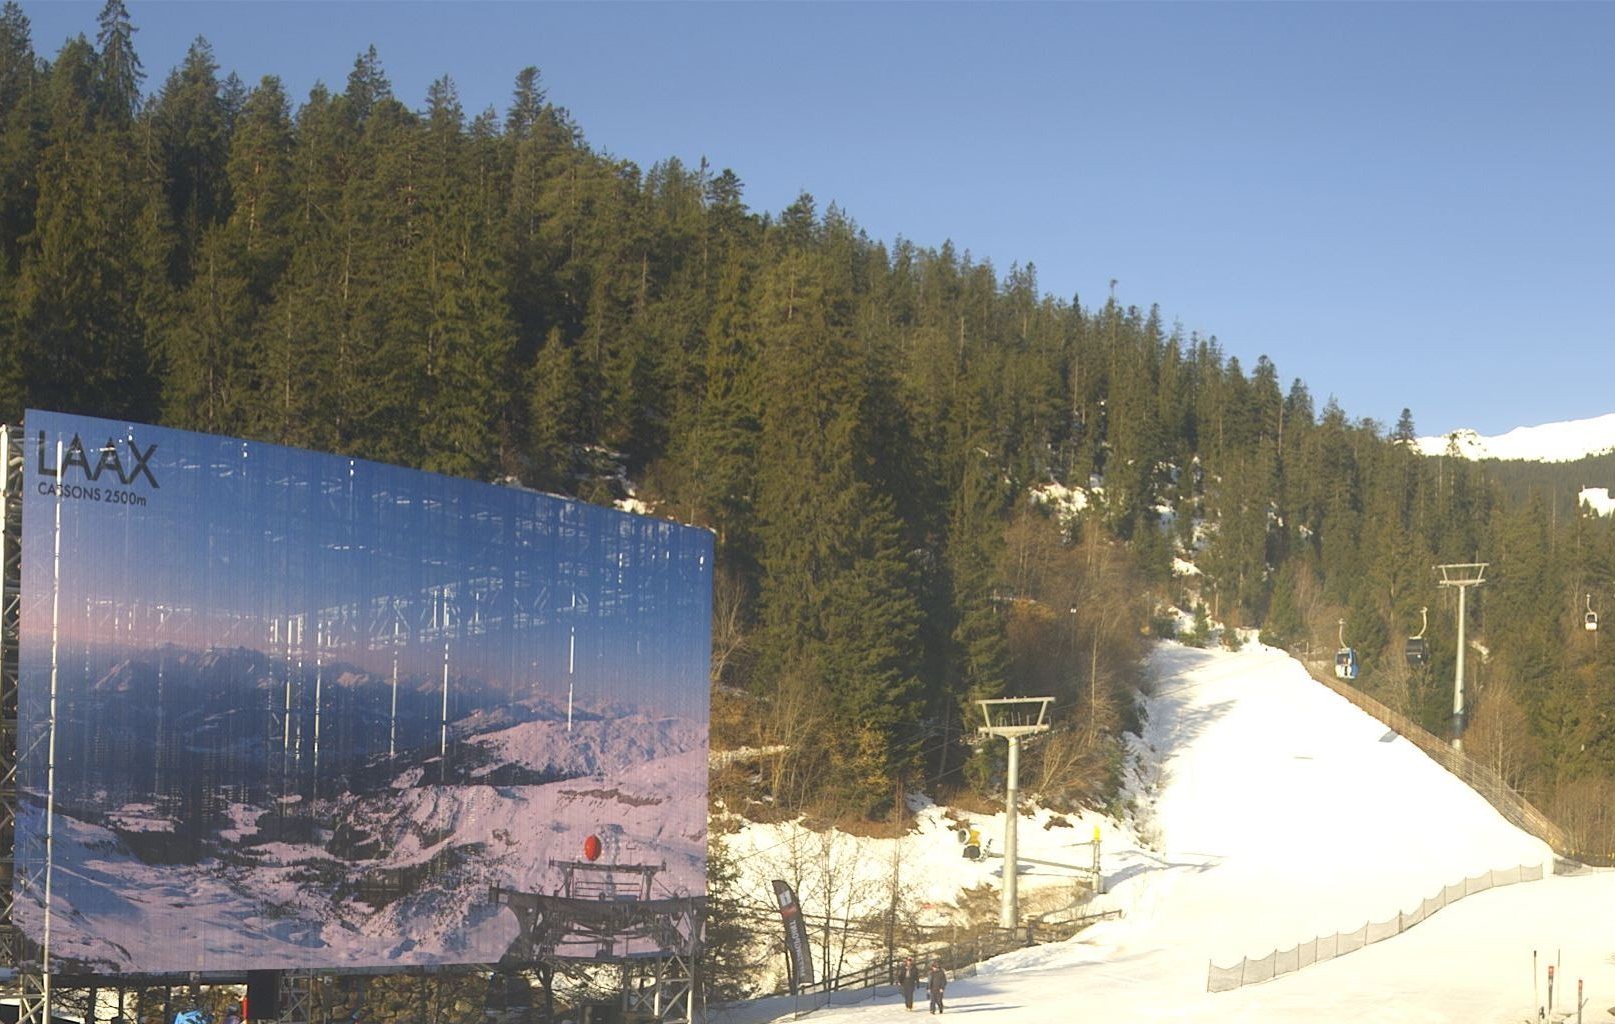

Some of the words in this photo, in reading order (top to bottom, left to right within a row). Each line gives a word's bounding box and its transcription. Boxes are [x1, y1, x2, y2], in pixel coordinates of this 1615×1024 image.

[37, 430, 160, 489] LAAX
[37, 482, 101, 501] CASSONS
[105, 489, 147, 507] 2500m
